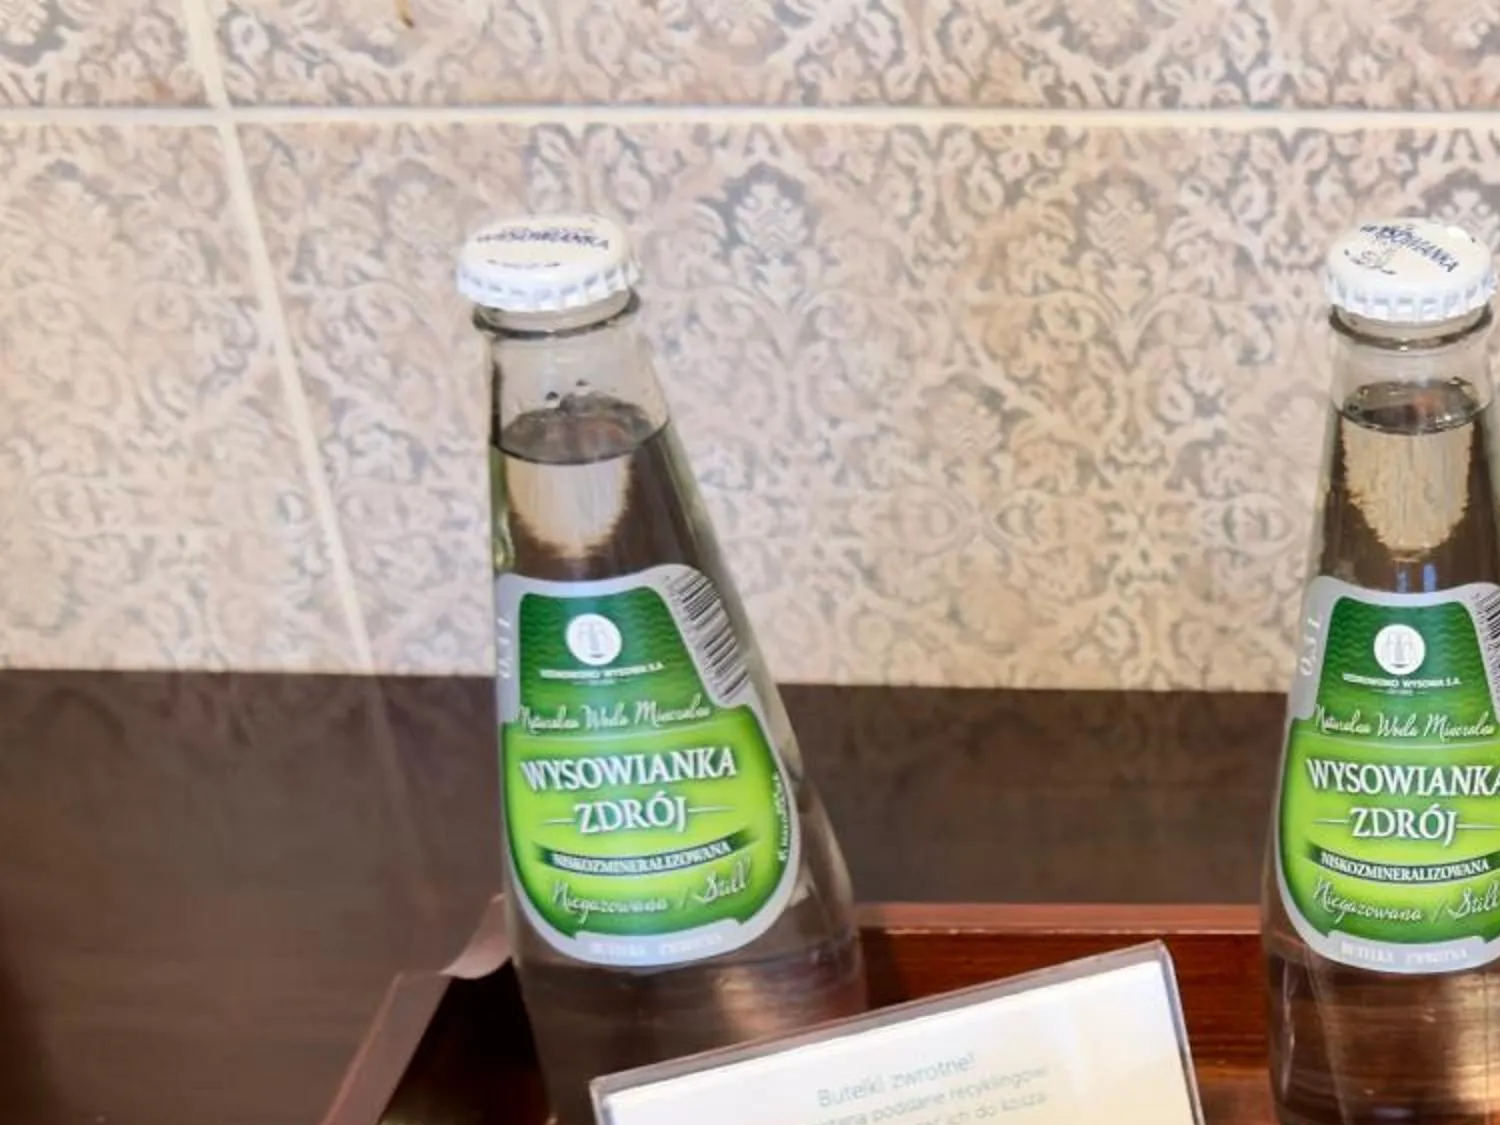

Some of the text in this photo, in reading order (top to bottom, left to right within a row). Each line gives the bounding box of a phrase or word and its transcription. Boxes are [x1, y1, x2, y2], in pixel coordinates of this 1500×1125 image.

[520, 746, 737, 792] WYSOWIANKA
[573, 791, 688, 834] ZDRÓJ
[1348, 804, 1458, 847] ZDRÓJ
[1320, 850, 1490, 882] NISKOZMINERALIZOWANA
[1313, 876, 1424, 925] Niegazowana
[817, 1074, 886, 1109] Butelki
